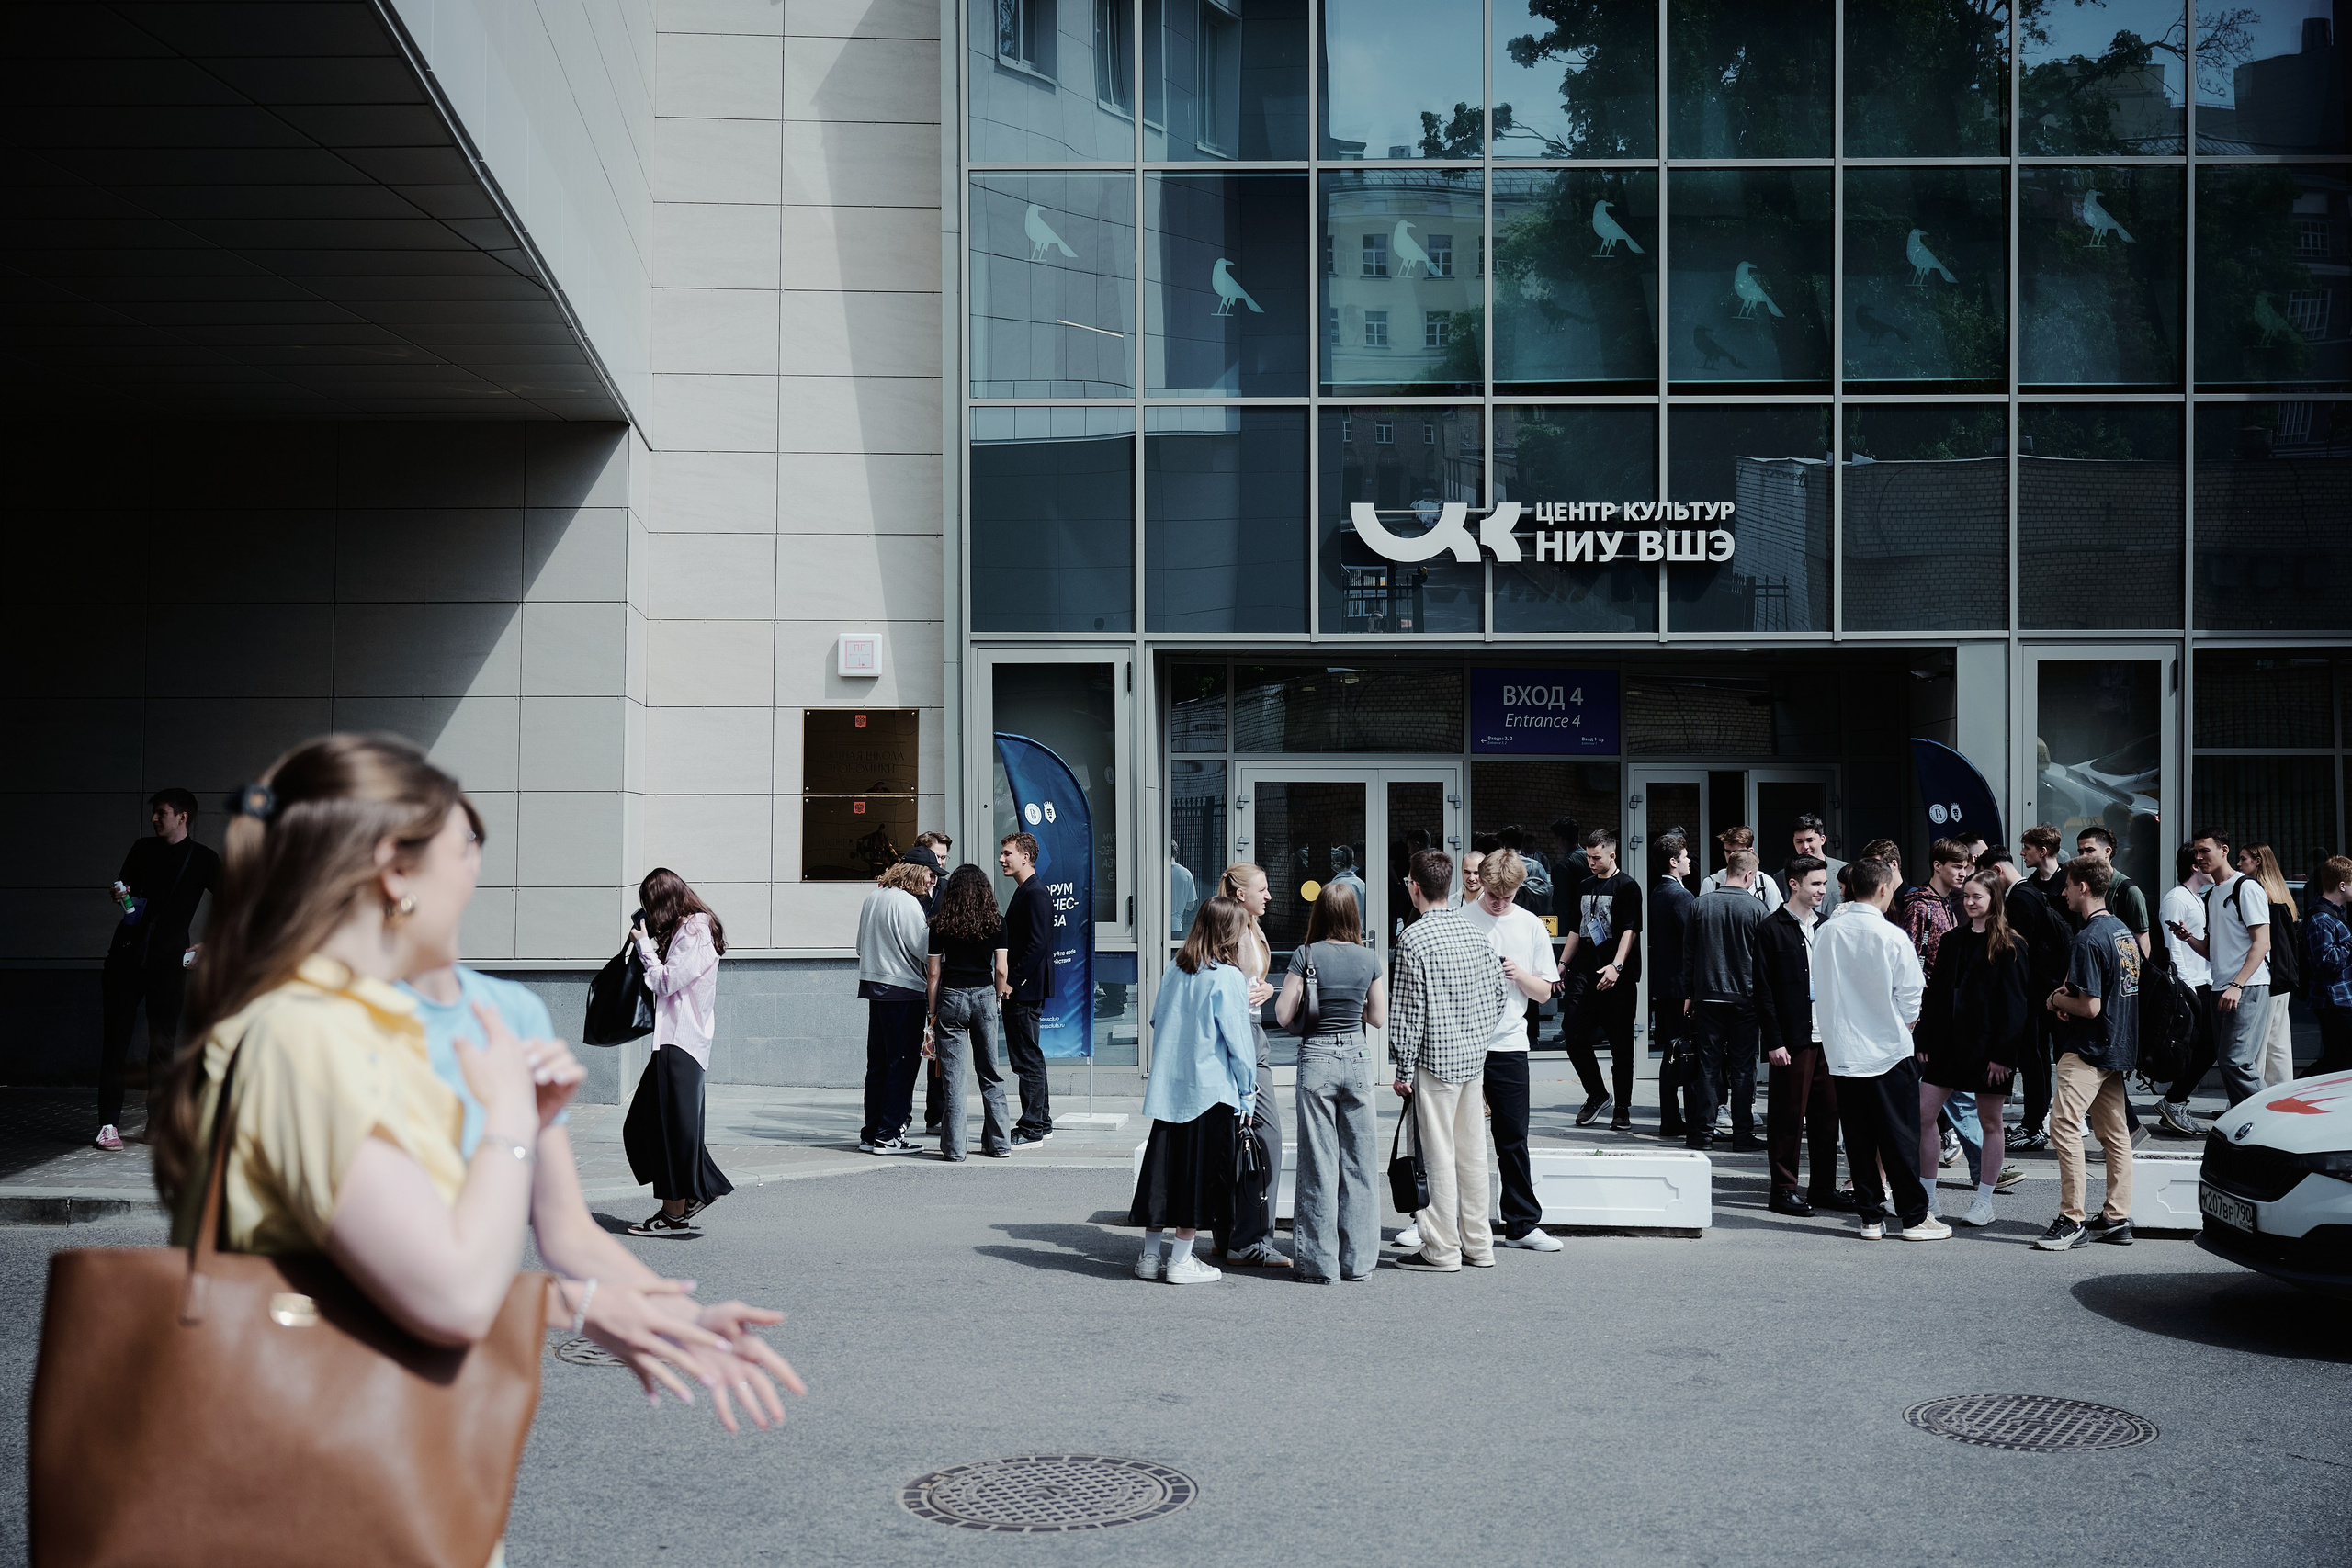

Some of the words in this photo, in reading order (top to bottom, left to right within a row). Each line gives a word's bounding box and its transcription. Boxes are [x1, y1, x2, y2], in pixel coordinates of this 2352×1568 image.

[1536, 502, 1616, 525] ЦЕНТР
[1623, 502, 1736, 522] КУЛЬТУР
[1536, 531, 1623, 562] НИУ
[1638, 530, 1736, 562] ВШЭ
[1503, 685, 1566, 710] ВХОД
[1570, 687, 1584, 706] 4
[1505, 714, 1569, 728] Entrance
[1572, 715, 1581, 728] 4
[865, 750, 905, 761] ШКОЛА
[2235, 1202, 2252, 1223] 790
